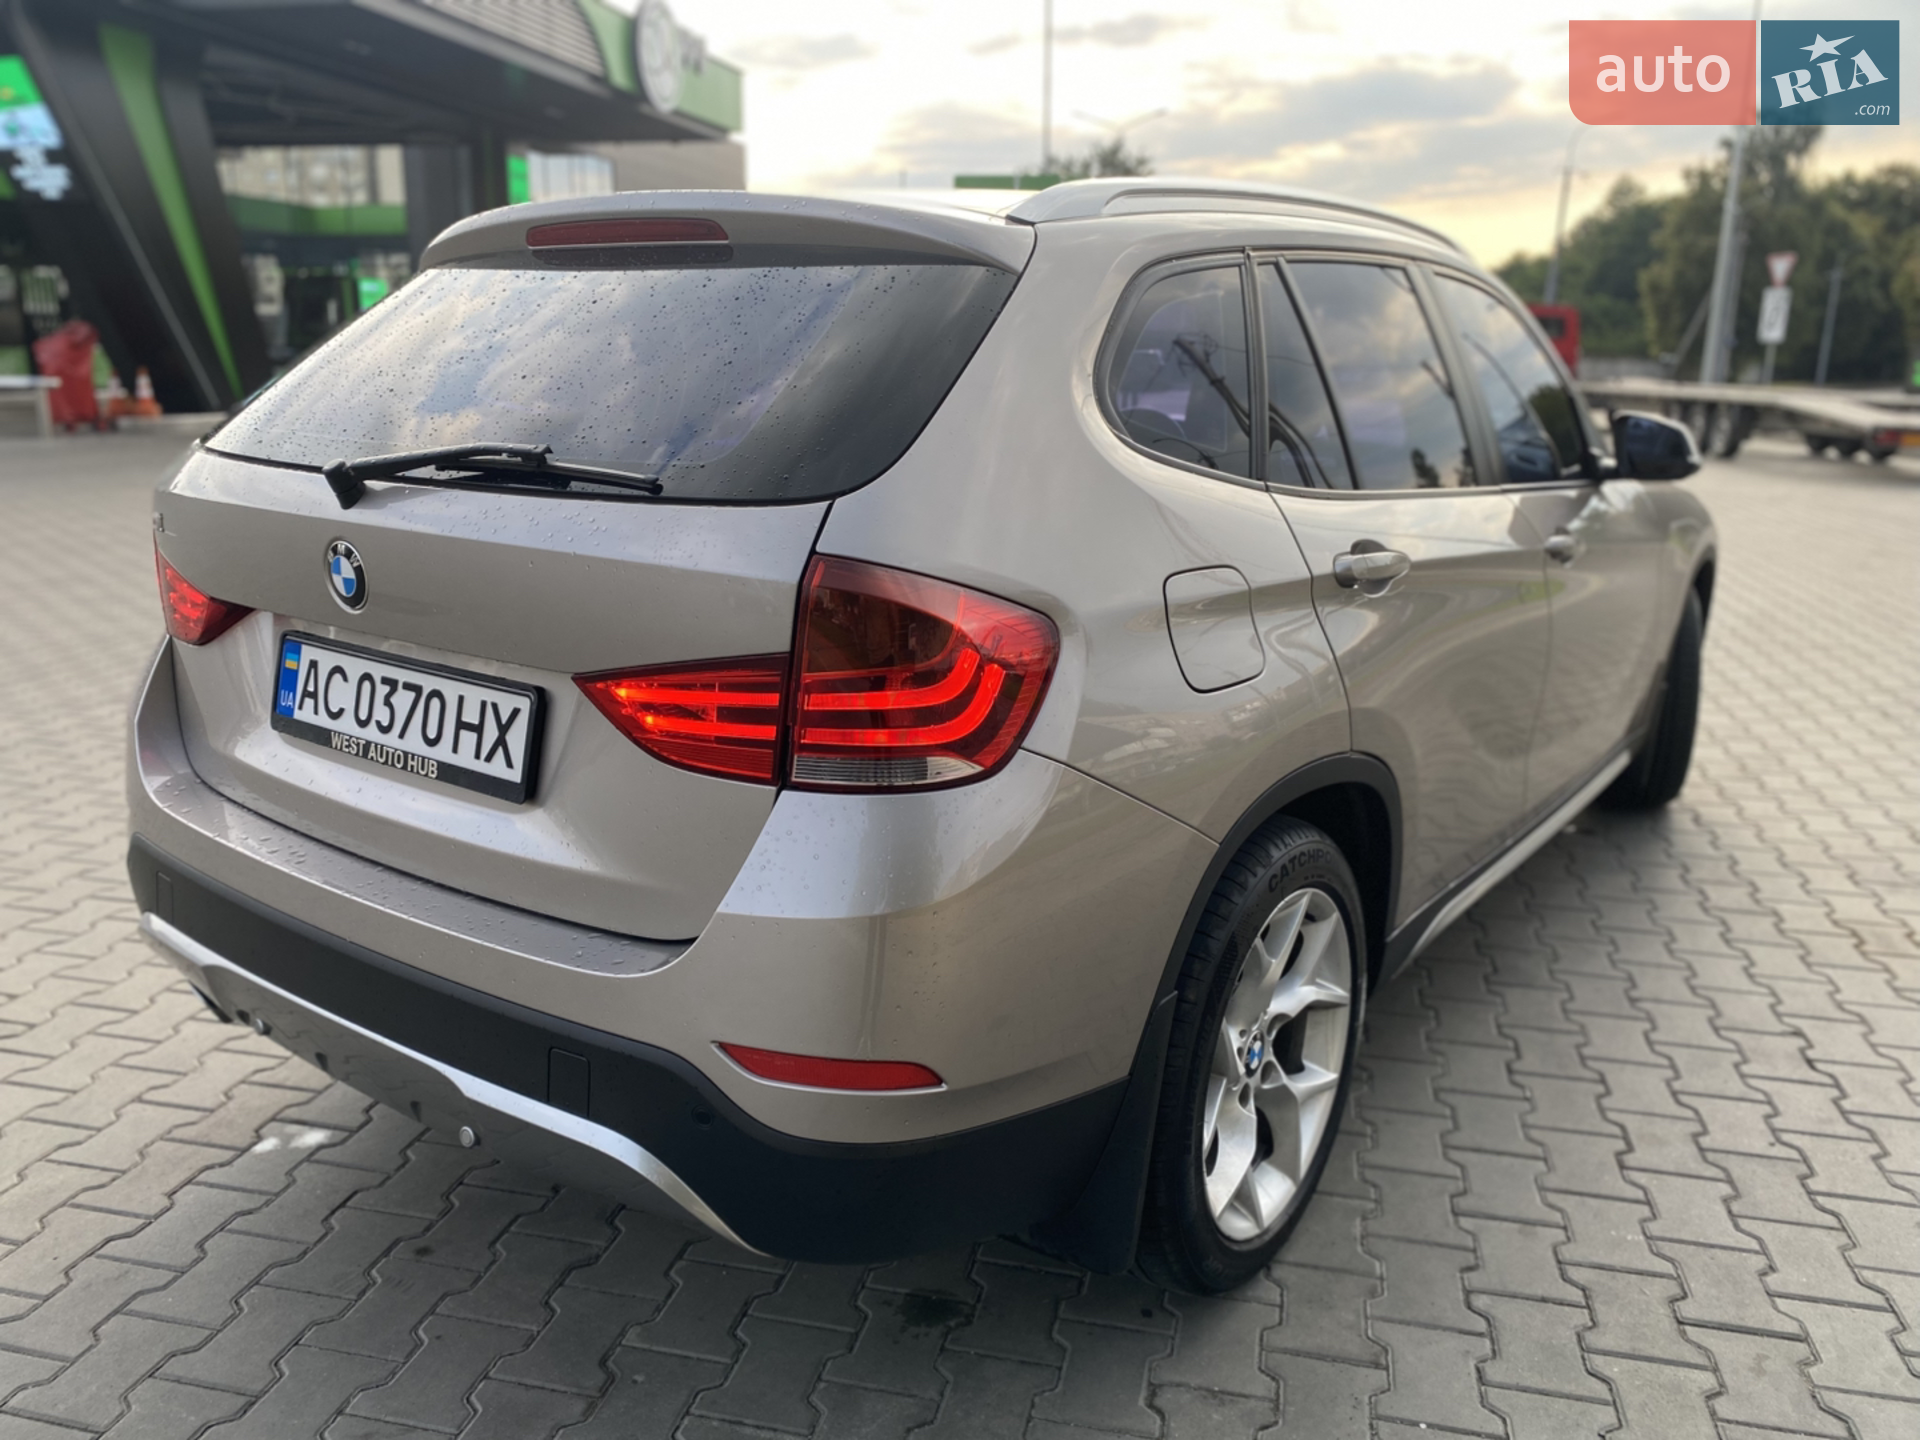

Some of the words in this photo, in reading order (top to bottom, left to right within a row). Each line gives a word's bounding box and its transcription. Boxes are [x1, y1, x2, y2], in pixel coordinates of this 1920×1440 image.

[280, 689, 294, 709] UA
[331, 731, 366, 757] WEST
[368, 746, 404, 770] AUTO
[407, 754, 439, 779] HUB
